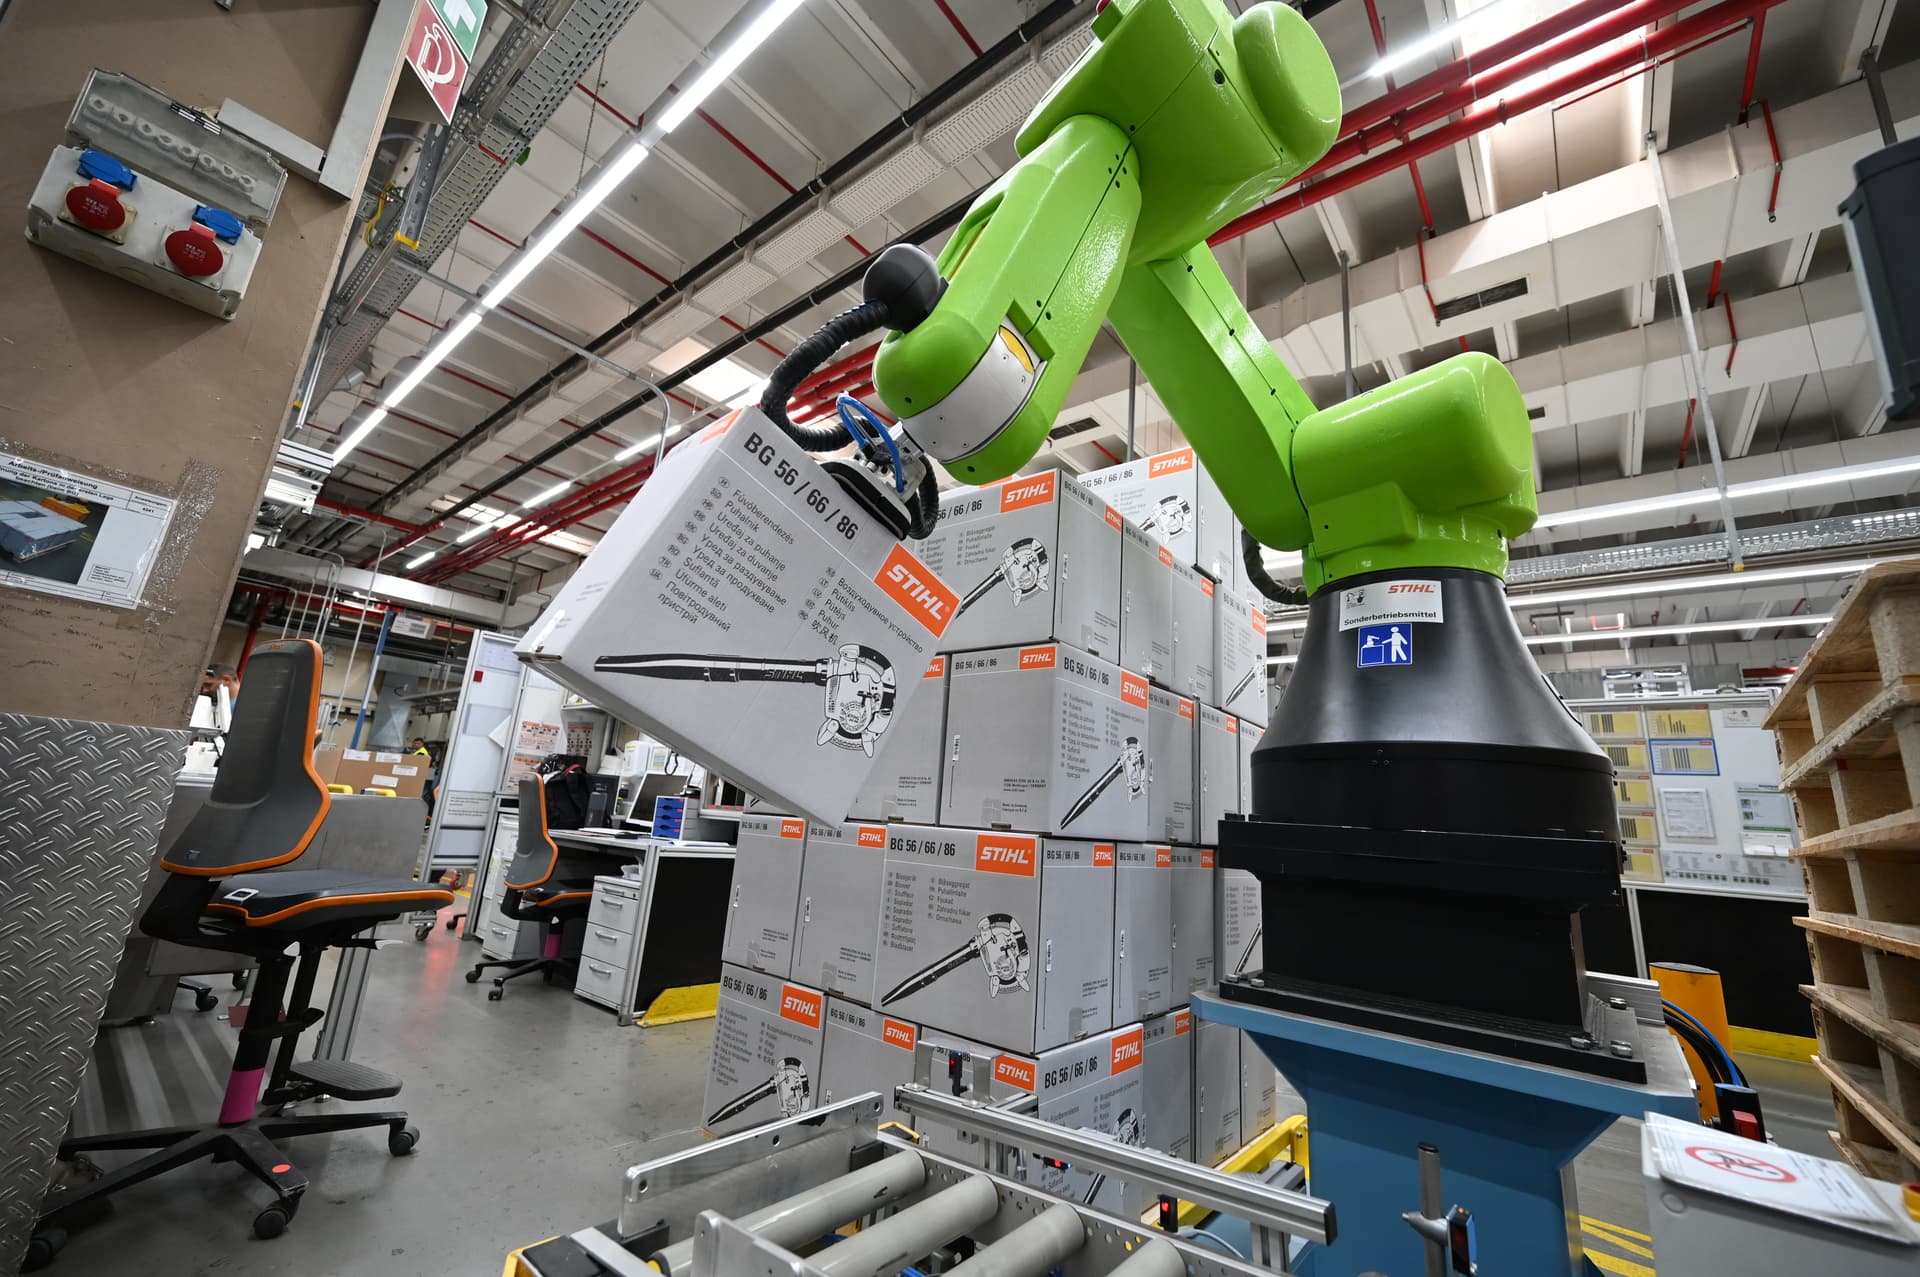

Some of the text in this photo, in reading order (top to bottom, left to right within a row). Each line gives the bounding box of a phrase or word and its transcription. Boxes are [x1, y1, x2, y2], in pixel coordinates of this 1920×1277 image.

[1152, 455, 1188, 472] STIHL
[744, 432, 775, 466] BG
[775, 460, 798, 486] 56
[807, 488, 829, 514] 66
[838, 516, 858, 540] 86
[1094, 478, 1102, 486] 56
[1108, 473, 1118, 482] 66
[1124, 470, 1133, 479] 86
[1004, 482, 1049, 504] STIHL
[725, 500, 760, 532] Puhalnik
[733, 489, 794, 544] Fúvóberendezés
[954, 504, 964, 516] 66
[972, 500, 982, 511] 86
[701, 534, 723, 557] Уред
[723, 554, 734, 564] за
[709, 522, 778, 582] Uređaj za duvanje
[717, 512, 745, 540] Uređaj
[744, 535, 754, 546] za
[754, 544, 786, 572] puhanje
[683, 557, 720, 588] Suflantă
[693, 545, 775, 613] Уред за продухване
[675, 568, 708, 598] Üfürme
[708, 595, 728, 612] aleti
[886, 564, 945, 620] STIHL
[1388, 584, 1434, 594] STIHL
[658, 593, 699, 624] пристрій
[665, 581, 731, 632] Повітродувний
[818, 609, 839, 630] Puhur
[837, 578, 923, 653] Воздуходувное устройство
[1344, 612, 1436, 626] Sonderbetriebsmittel
[926, 663, 940, 672] IHL
[956, 662, 964, 670] BG
[966, 661, 973, 669] 56
[977, 660, 985, 668] 66
[990, 658, 997, 667] 86
[1022, 654, 1050, 663] STIHL
[1064, 657, 1075, 673] BG
[1076, 662, 1084, 676] 56
[1089, 667, 1097, 681] 66
[1102, 672, 1109, 686] 86
[1123, 682, 1146, 699] STIHL
[782, 825, 801, 833] STIHL
[860, 833, 882, 842] STIHL
[890, 838, 903, 851] BG
[906, 840, 916, 852] 56
[925, 842, 936, 854] 66
[944, 843, 955, 856] 86
[981, 847, 1029, 864] STIHL
[1095, 852, 1112, 861] STIHL
[723, 976, 733, 989] BG
[734, 980, 742, 991] 56
[746, 983, 754, 995] 66
[759, 988, 767, 1000] 86
[784, 997, 816, 1017] STIHL
[831, 1008, 838, 1018] BG
[839, 1010, 845, 1020] 56
[849, 1013, 855, 1024] 66
[859, 1016, 865, 1027] 86
[886, 1027, 910, 1043] STIHL
[1114, 1041, 1140, 1063] STIHL
[998, 1063, 1030, 1082] STIHL
[1045, 1070, 1057, 1089] BG
[1059, 1067, 1068, 1083] 56
[1074, 1062, 1083, 1078] 66
[1089, 1056, 1098, 1072] 86
